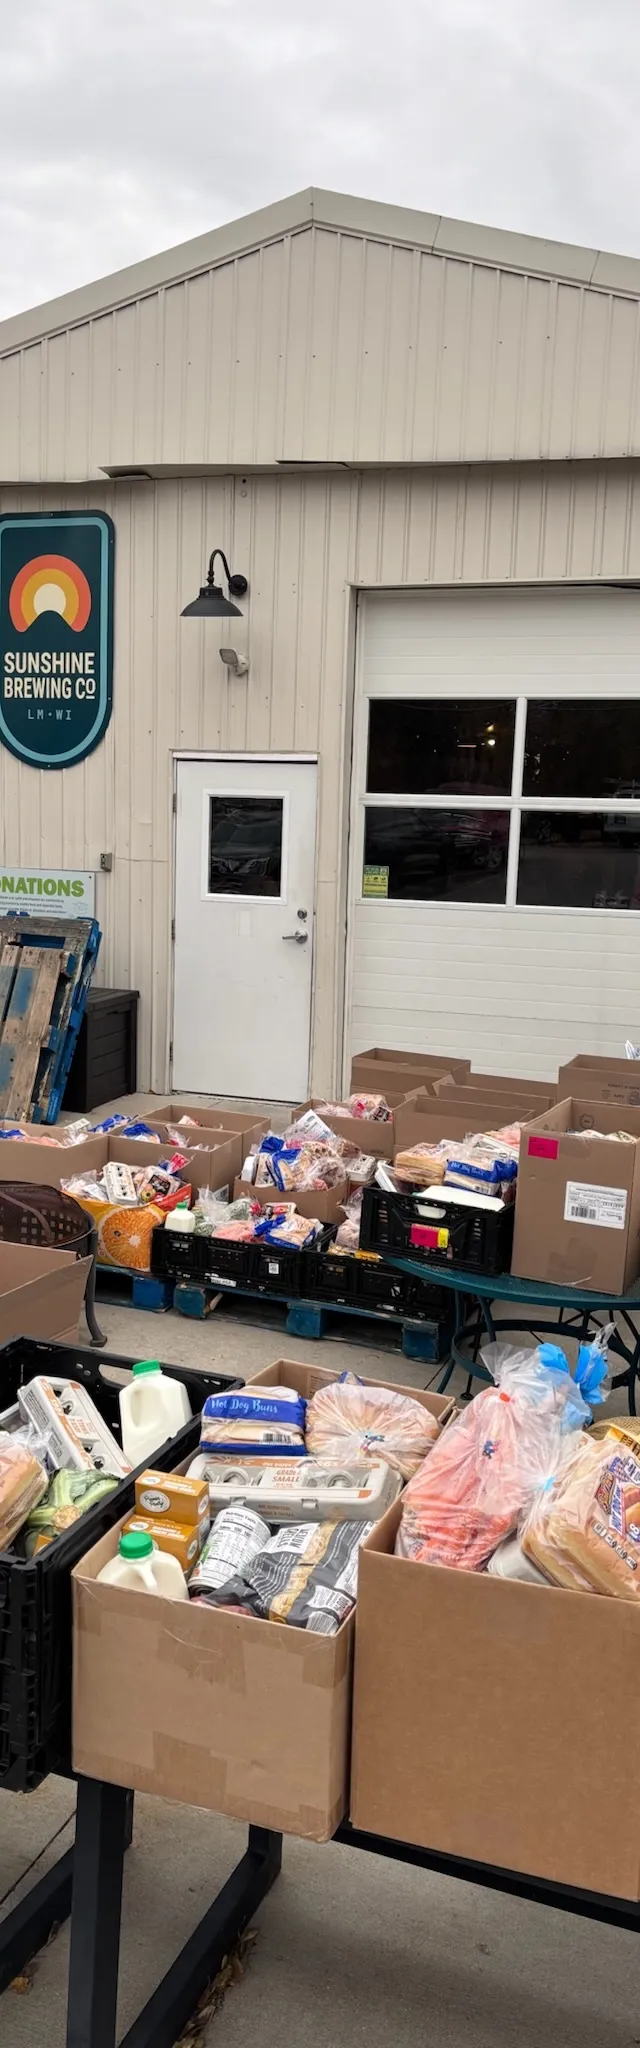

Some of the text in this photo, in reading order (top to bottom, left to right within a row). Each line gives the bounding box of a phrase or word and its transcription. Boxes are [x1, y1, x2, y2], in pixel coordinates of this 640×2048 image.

[4, 652, 95, 674] SUNSHINE
[4, 677, 72, 699] BREWING
[0, 876, 85, 898] NATIONS
[211, 1399, 278, 1414] Hot Dog Buns
